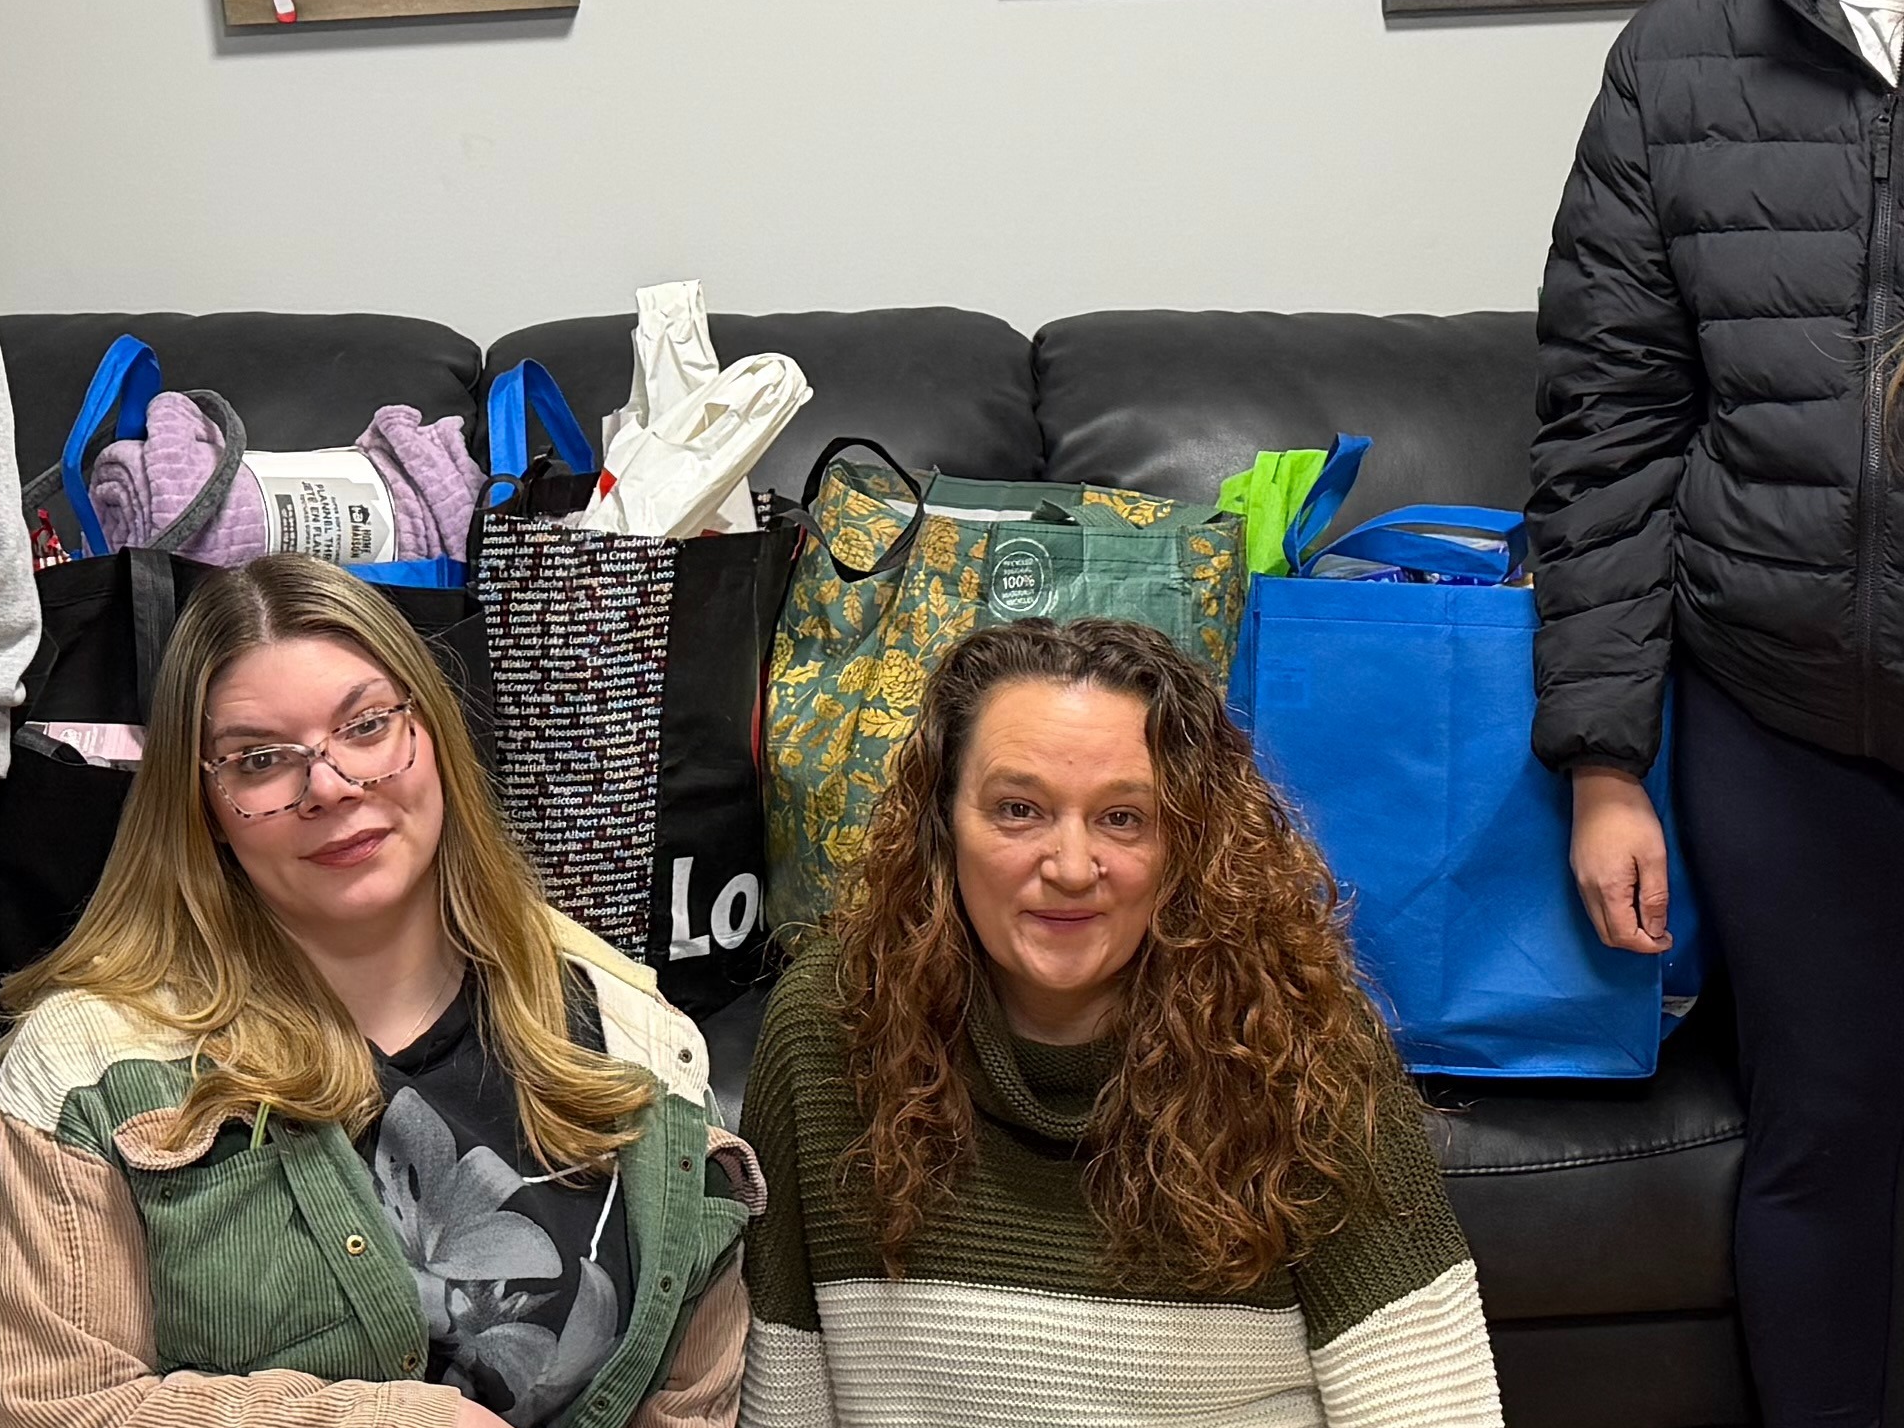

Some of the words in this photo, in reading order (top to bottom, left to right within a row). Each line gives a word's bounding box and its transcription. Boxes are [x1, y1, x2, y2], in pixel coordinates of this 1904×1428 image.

[310, 506, 322, 524] EN
[315, 483, 333, 534] FLANNEL
[349, 525, 362, 559] MAISON
[360, 528, 373, 556] HOME
[601, 562, 647, 573] Wolseley
[1003, 575, 1035, 589] 100%
[512, 591, 548, 600] Medicine
[602, 597, 640, 607] Macklin
[574, 609, 626, 620] Lethbridge
[597, 621, 630, 632] Lipton
[586, 653, 642, 666] Claresholm
[588, 676, 635, 689] Meacham
[550, 705, 574, 715] Swan
[608, 696, 655, 710] Milestone
[529, 717, 571, 728] Duperow
[580, 711, 632, 725] Minnedosa
[546, 728, 595, 737] Moosomin
[626, 719, 659, 733] Agathe
[530, 740, 572, 749] Nanaimo
[582, 733, 637, 748] Choiceland
[607, 742, 646, 757] Neudorf
[571, 761, 601, 771] North
[546, 773, 594, 783] Waldheim
[604, 766, 645, 780] Oakville
[548, 785, 592, 795] Pangman
[538, 796, 583, 806] Penticton
[592, 791, 639, 803] Montrose
[564, 806, 611, 816] Meadows
[622, 798, 655, 812] Eatonia
[577, 818, 598, 828] Port
[564, 829, 595, 839] Albert
[569, 853, 603, 862] Reston
[563, 861, 615, 874] Rocanville
[593, 870, 637, 883] Rosenort
[576, 885, 614, 895] Salmon
[615, 881, 637, 891] Arm
[558, 897, 594, 908] Sedalia
[669, 857, 764, 961] Lo
[584, 906, 618, 916] Moose
